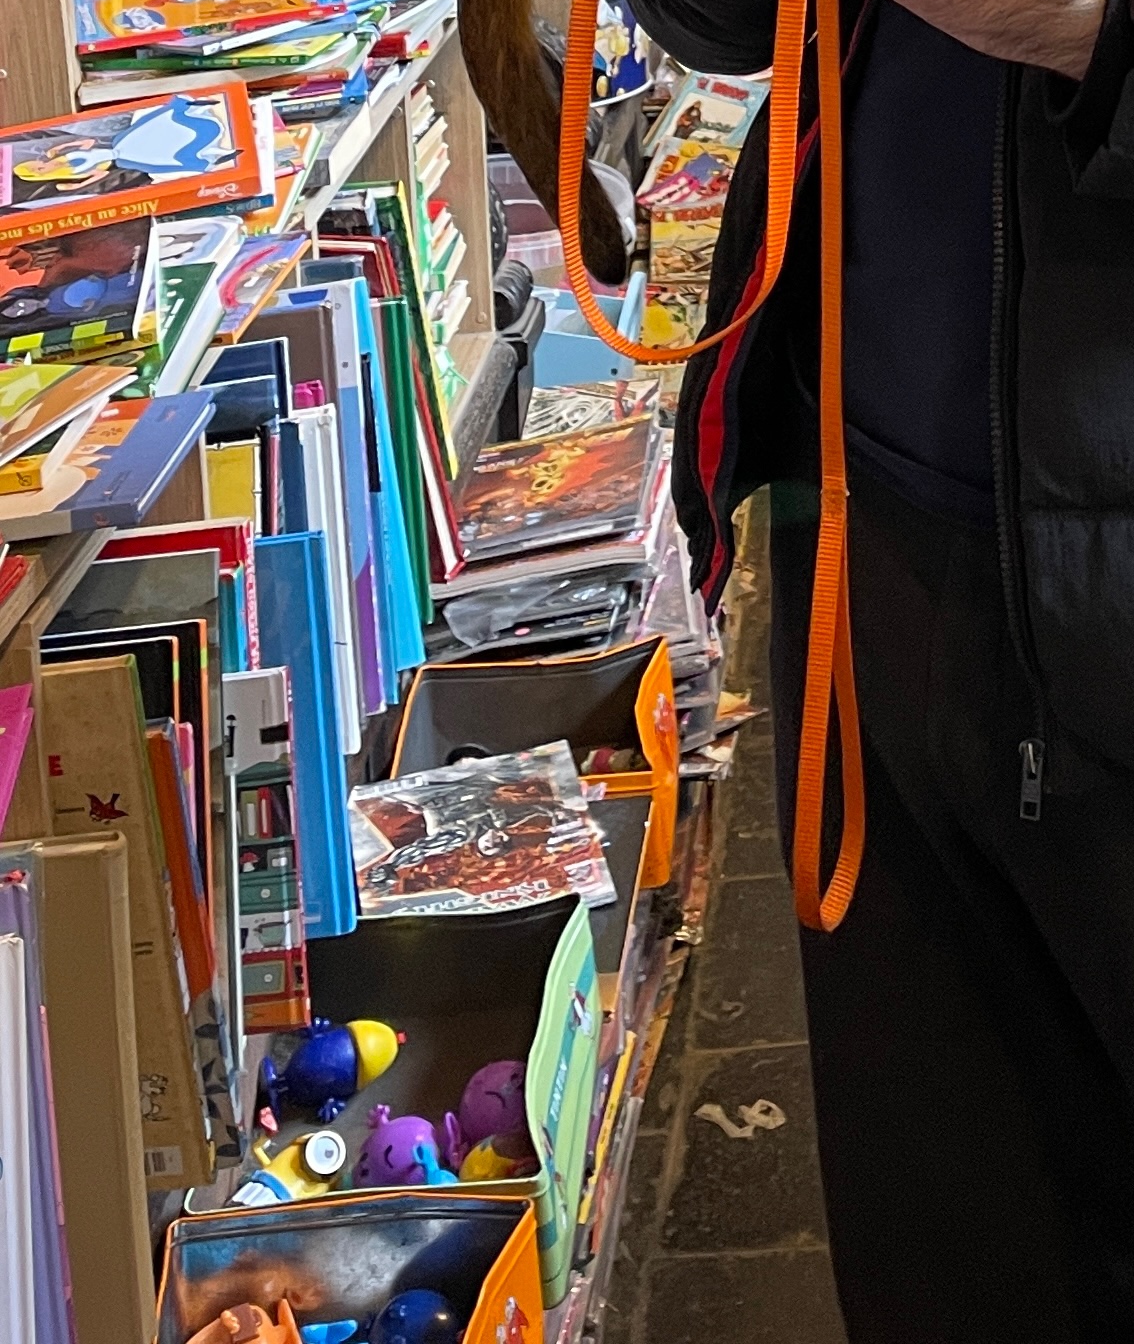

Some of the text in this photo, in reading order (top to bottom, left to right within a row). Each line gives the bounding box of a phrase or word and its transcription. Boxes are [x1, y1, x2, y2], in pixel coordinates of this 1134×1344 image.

[197, 182, 244, 199] Disney
[98, 208, 118, 221] au
[120, 199, 160, 217] Alice
[58, 213, 94, 229] Pays
[28, 222, 54, 239] des
